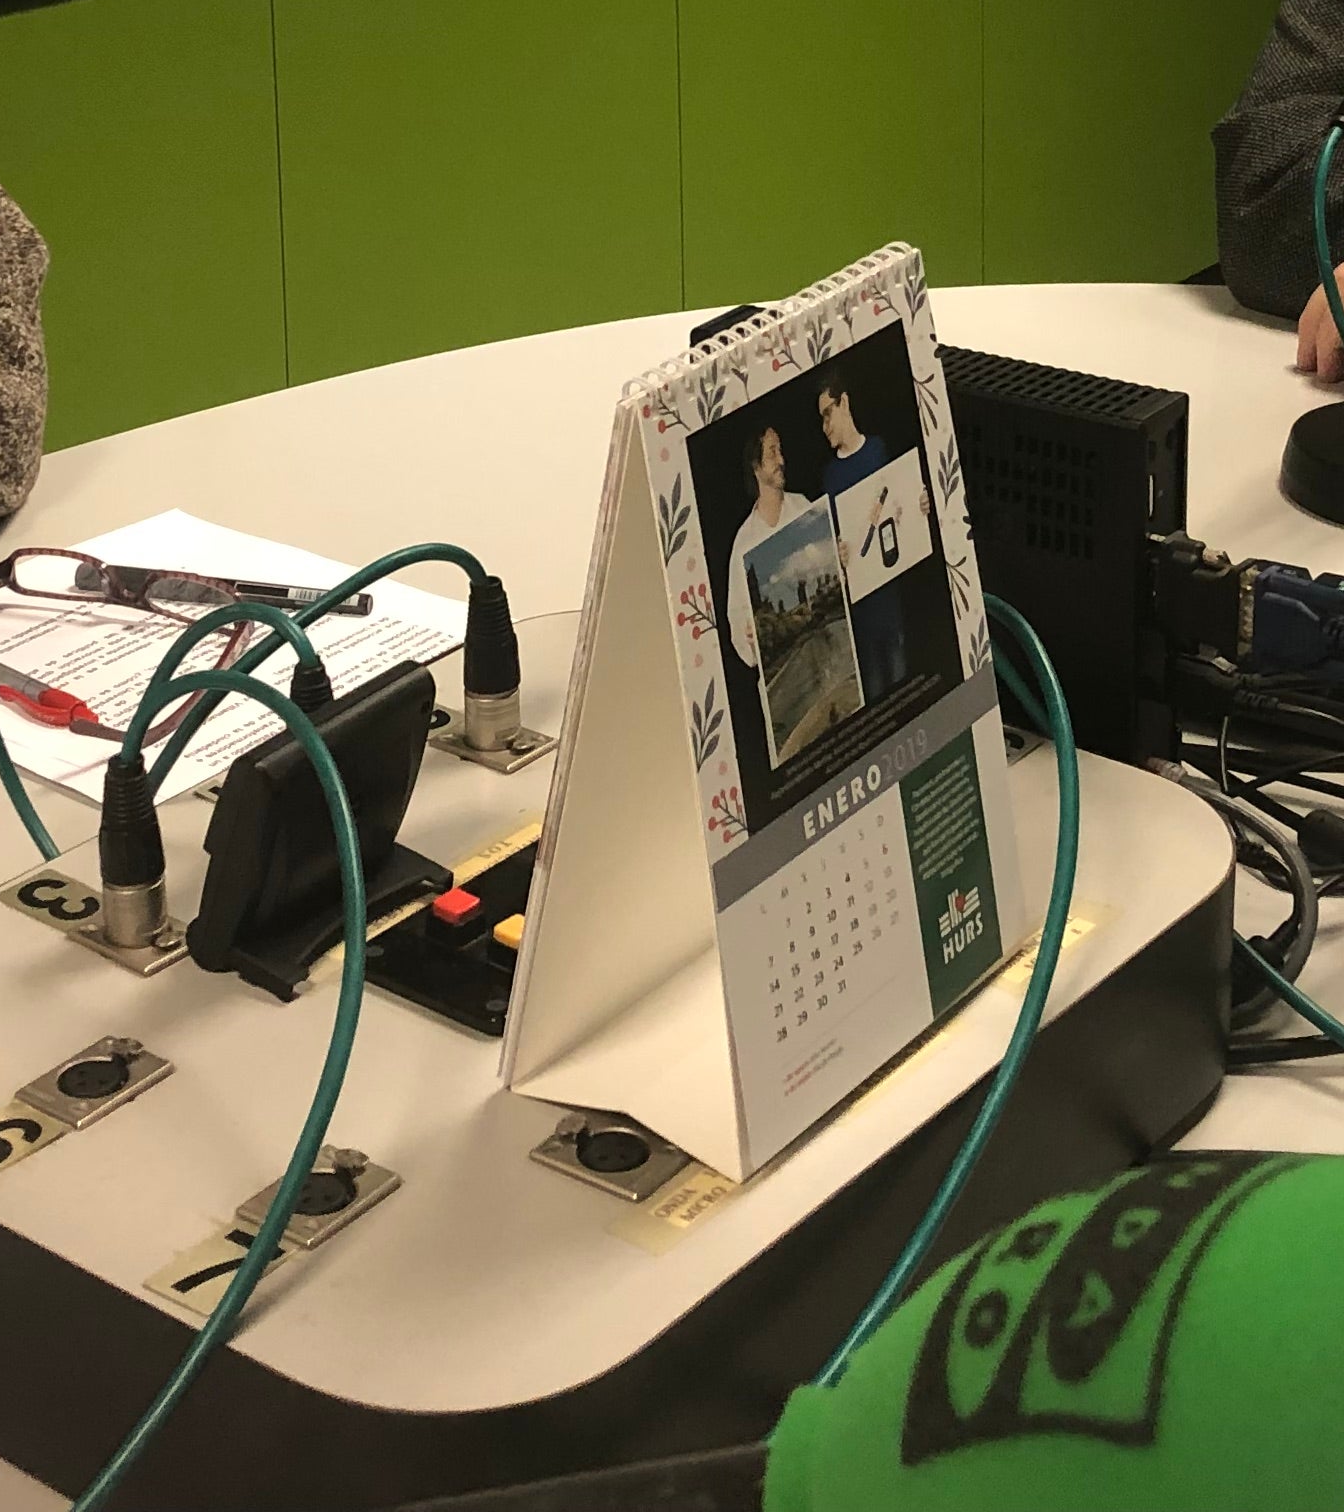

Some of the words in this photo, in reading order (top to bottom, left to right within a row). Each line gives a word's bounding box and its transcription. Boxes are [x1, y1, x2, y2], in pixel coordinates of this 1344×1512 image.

[802, 763, 882, 840] ENERO
[16, 878, 101, 923] 3
[941, 912, 984, 965] HURS
[679, 1185, 728, 1223] MICRO
